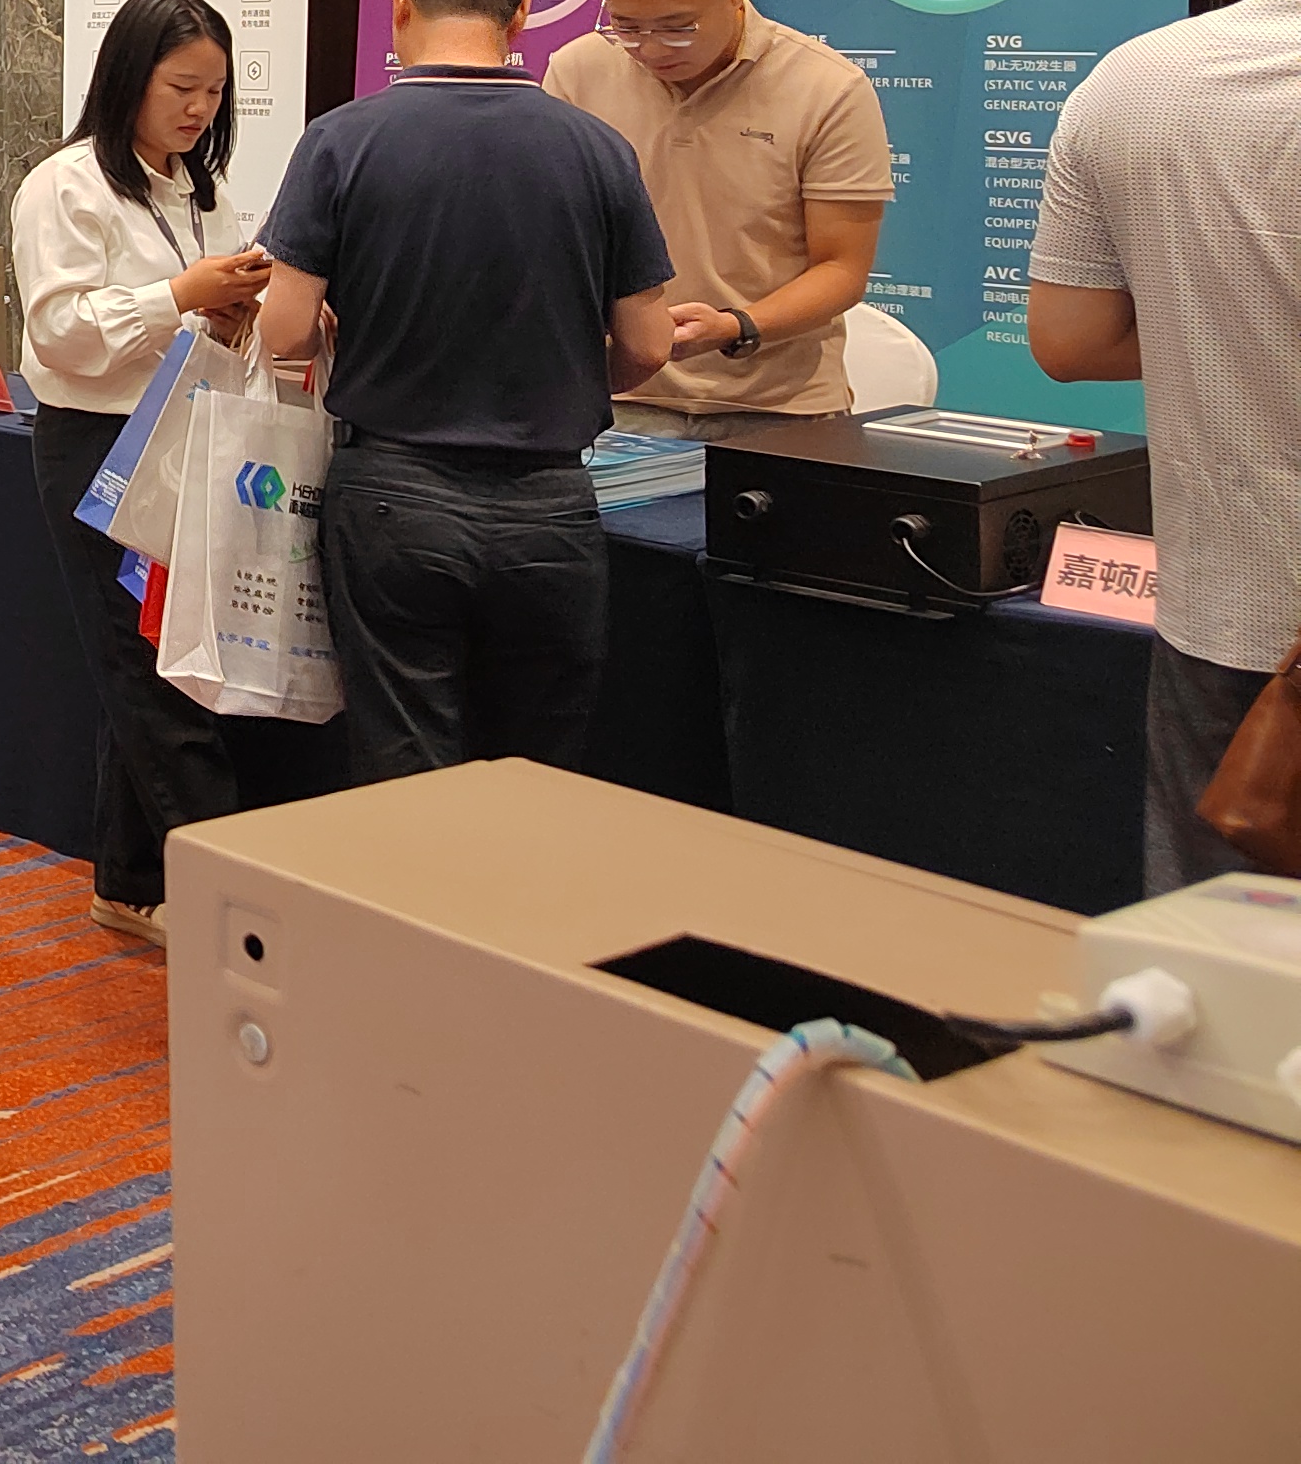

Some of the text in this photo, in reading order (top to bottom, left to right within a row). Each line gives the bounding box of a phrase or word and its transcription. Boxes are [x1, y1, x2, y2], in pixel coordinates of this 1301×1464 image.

[986, 35, 1022, 48] SVG
[893, 77, 933, 88] FILTER
[984, 79, 1067, 91] (STATIC VAR
[984, 130, 1032, 144] CSVG
[984, 266, 1021, 281] AVC
